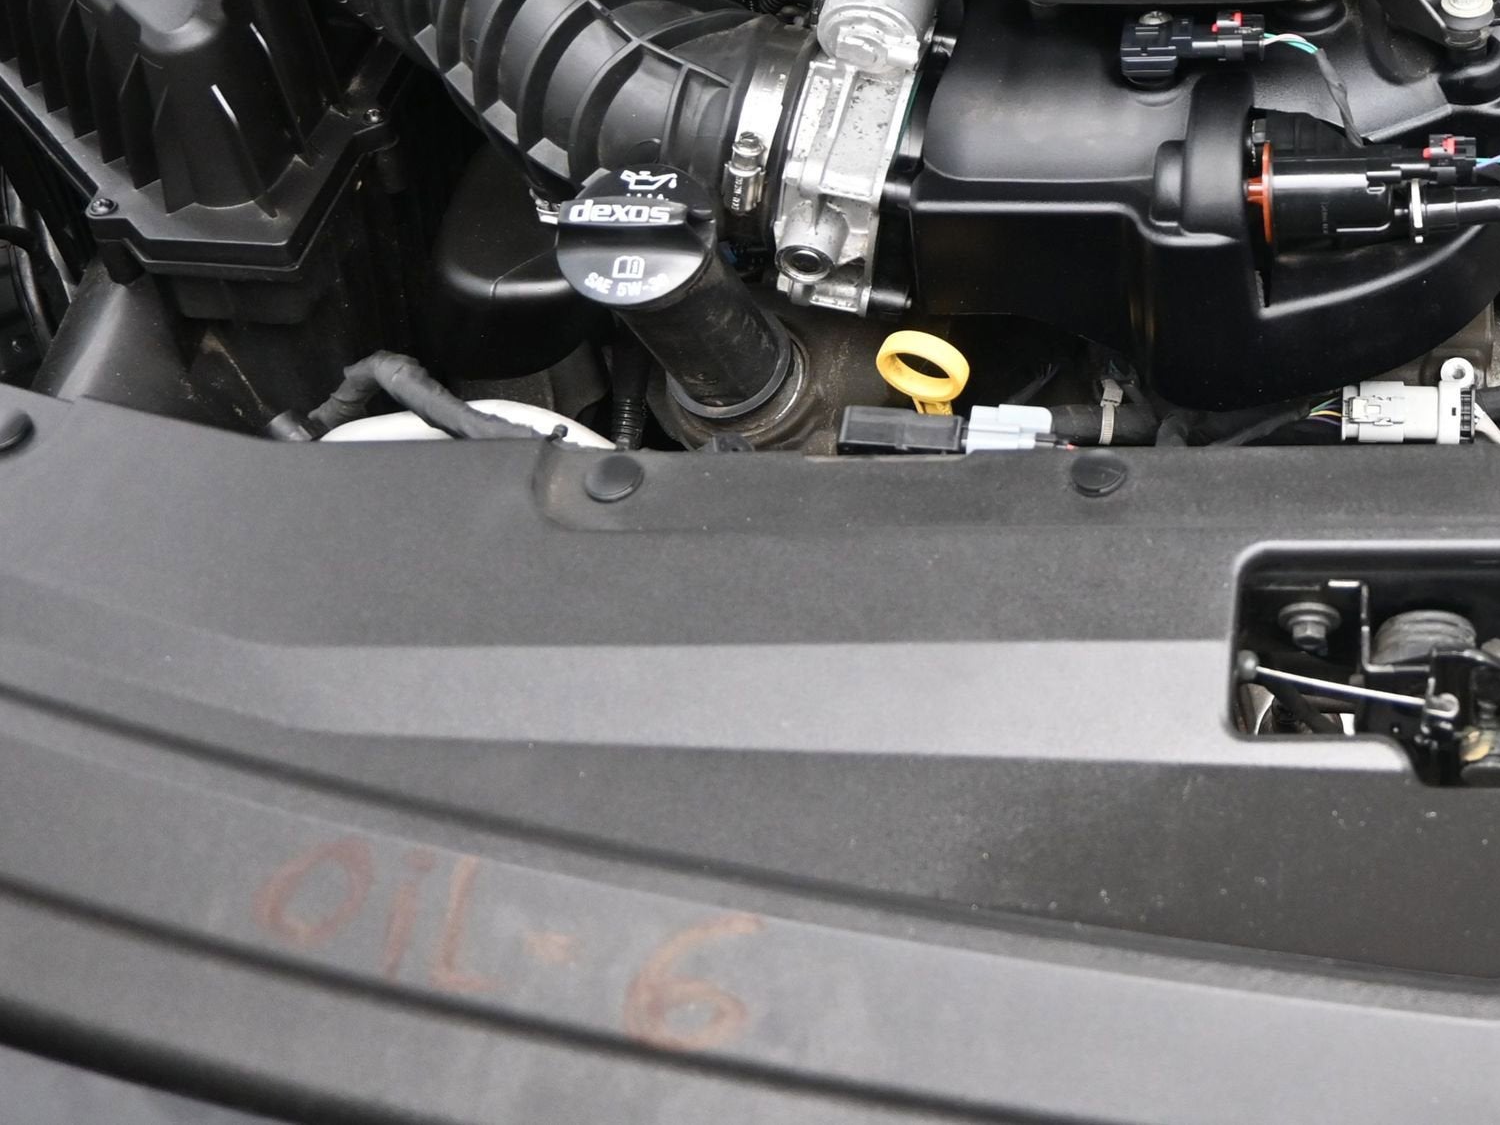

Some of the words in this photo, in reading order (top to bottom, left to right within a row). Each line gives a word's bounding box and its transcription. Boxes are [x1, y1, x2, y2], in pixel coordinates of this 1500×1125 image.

[568, 199, 671, 223] dexos
[584, 272, 613, 295] SAE
[623, 910, 766, 1053] 6
